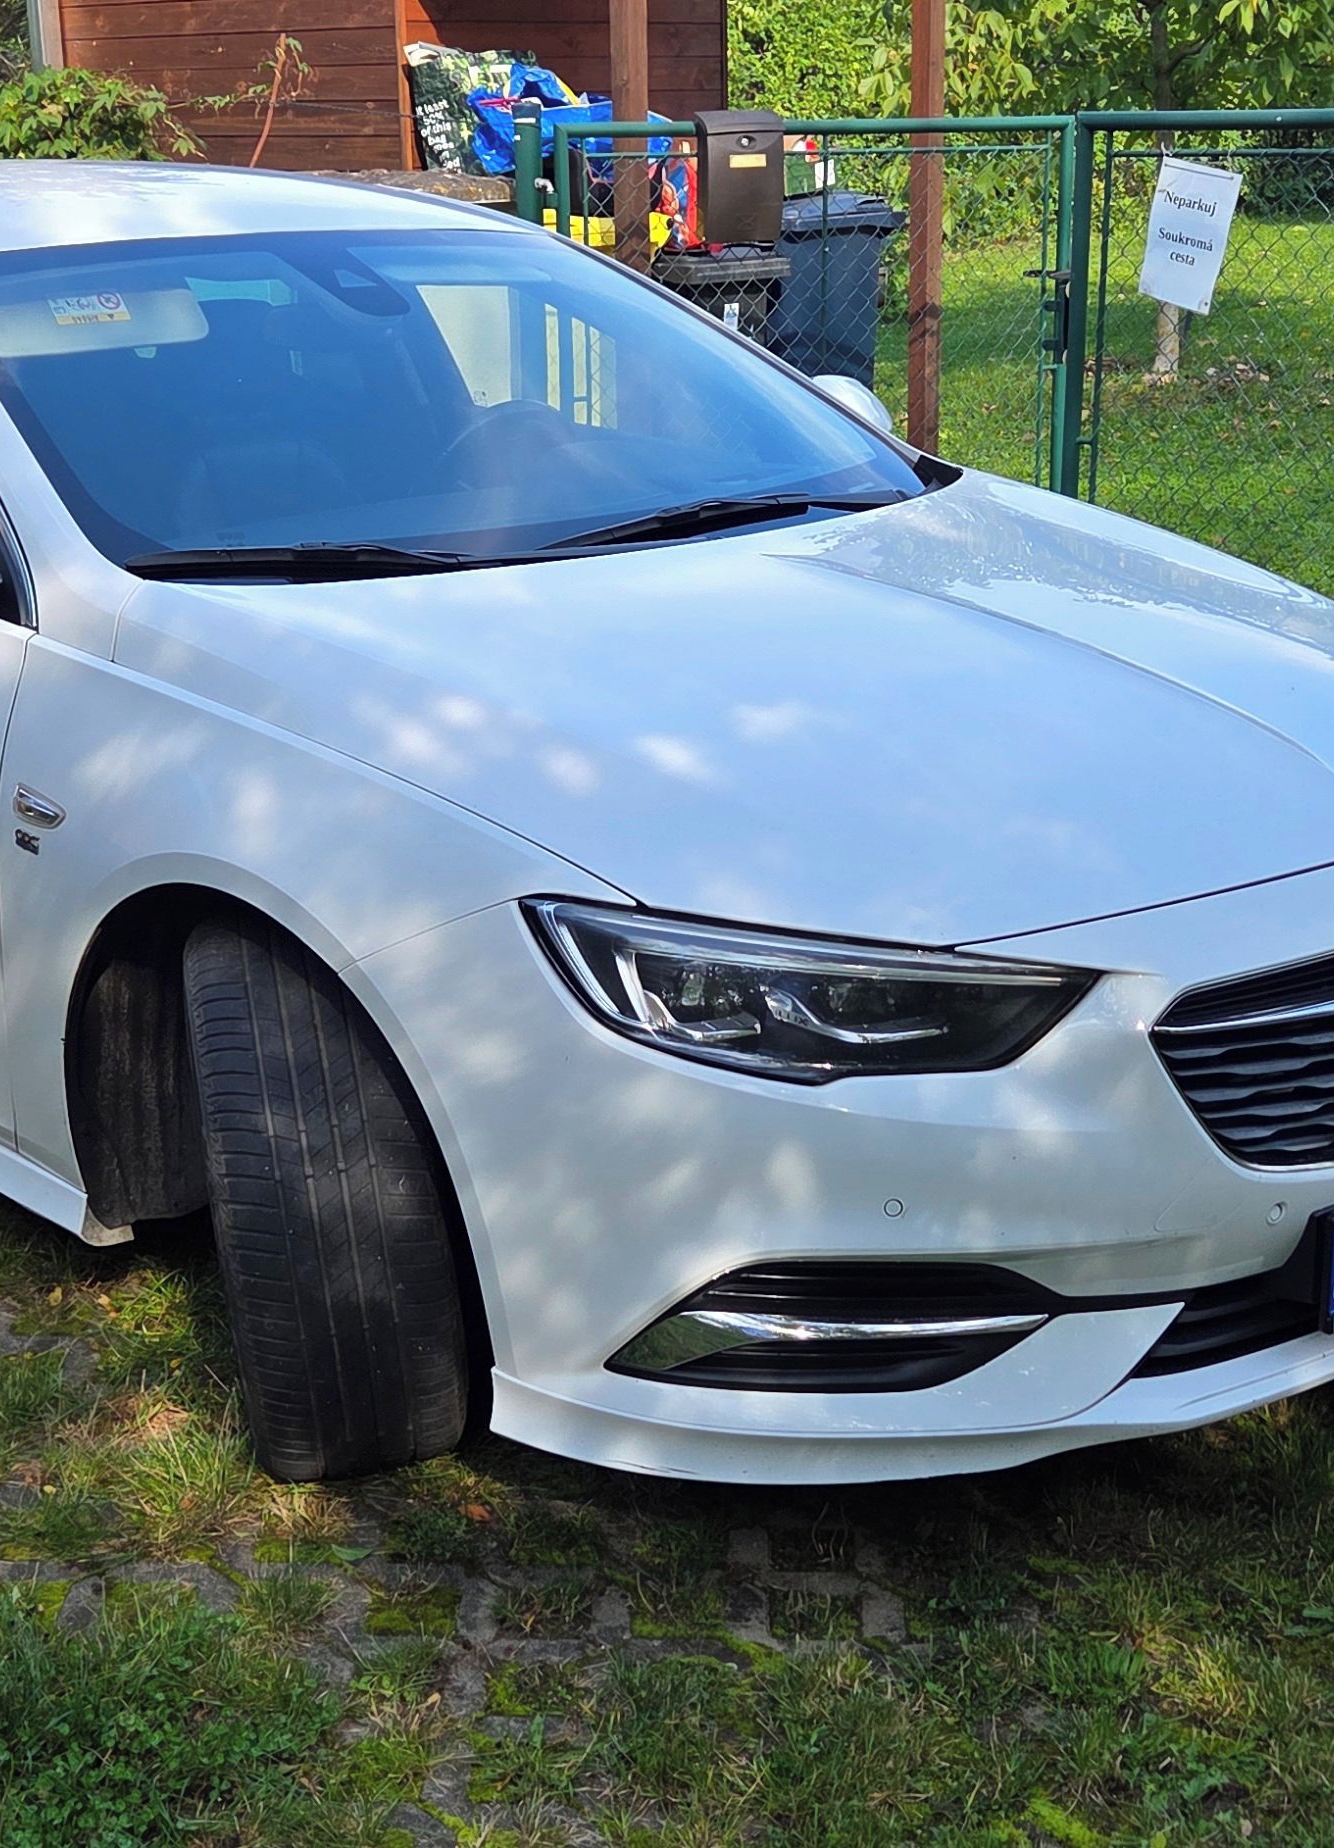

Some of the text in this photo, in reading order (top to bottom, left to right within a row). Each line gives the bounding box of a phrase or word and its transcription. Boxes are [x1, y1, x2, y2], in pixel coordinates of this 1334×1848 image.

[433, 122, 452, 134] this
[1164, 191, 1218, 217] Neparkuj
[1158, 227, 1213, 251] Soukromá
[1169, 251, 1195, 266] cesta
